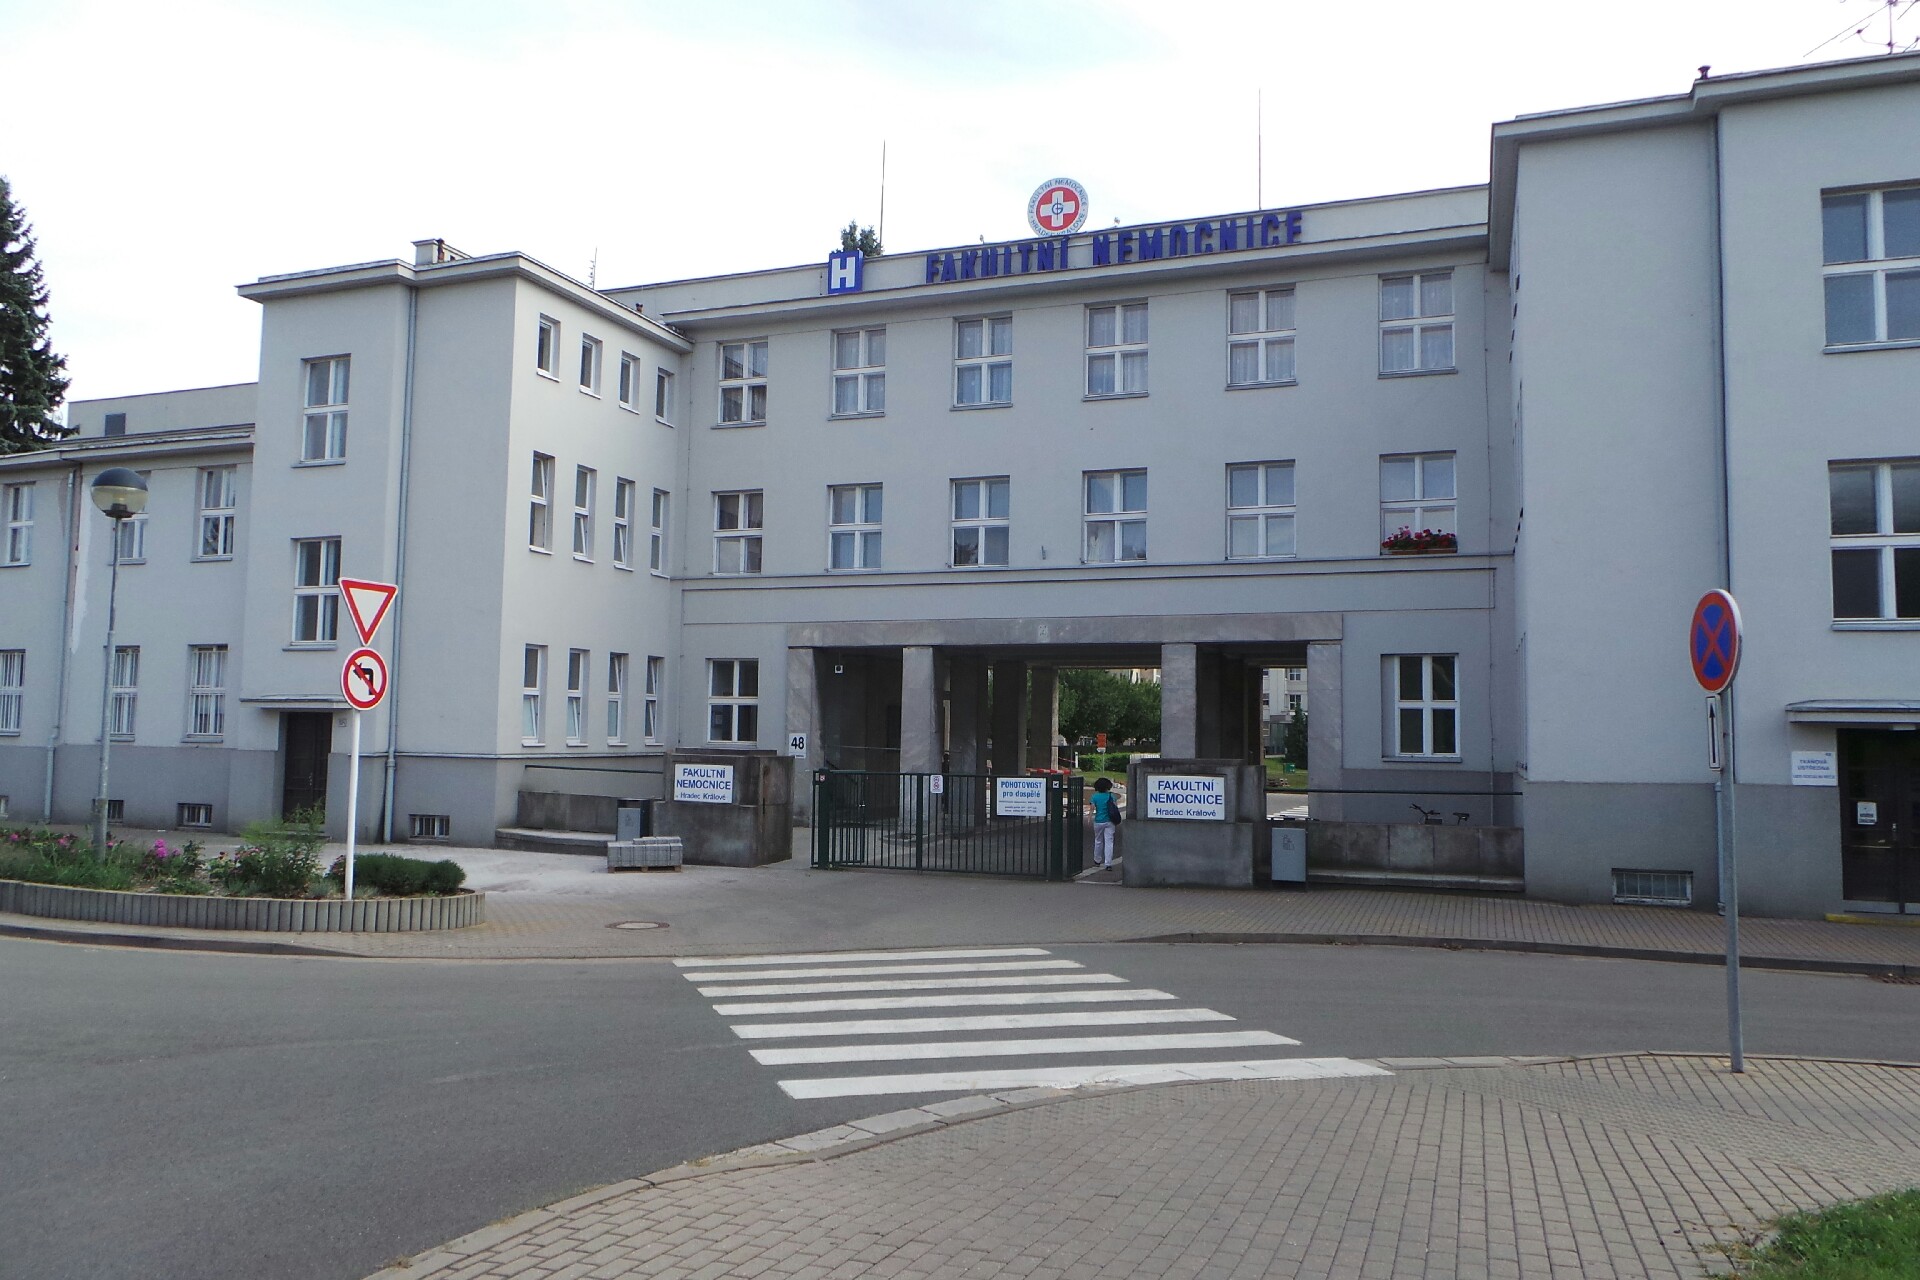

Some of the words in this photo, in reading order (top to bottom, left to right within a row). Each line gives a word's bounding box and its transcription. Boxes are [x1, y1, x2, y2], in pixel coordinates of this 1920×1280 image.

[926, 235, 1070, 284] FAKULTNÍ
[1093, 210, 1303, 266] NEMOCNICE
[830, 256, 856, 289] H
[791, 736, 805, 750] 48
[682, 767, 726, 779] FAKULTNÍ
[676, 779, 731, 790] NEMOCNICE
[1000, 781, 1042, 789] POHOTOVOST
[1158, 779, 1215, 791] FAKULTNÍ
[680, 792, 701, 800] Hradec
[703, 792, 726, 801] Králové
[1015, 790, 1041, 798] dospělé
[1149, 793, 1223, 805] NEMOCNICE
[1156, 808, 1184, 816] Hradec
[1186, 808, 1217, 817] Králové
